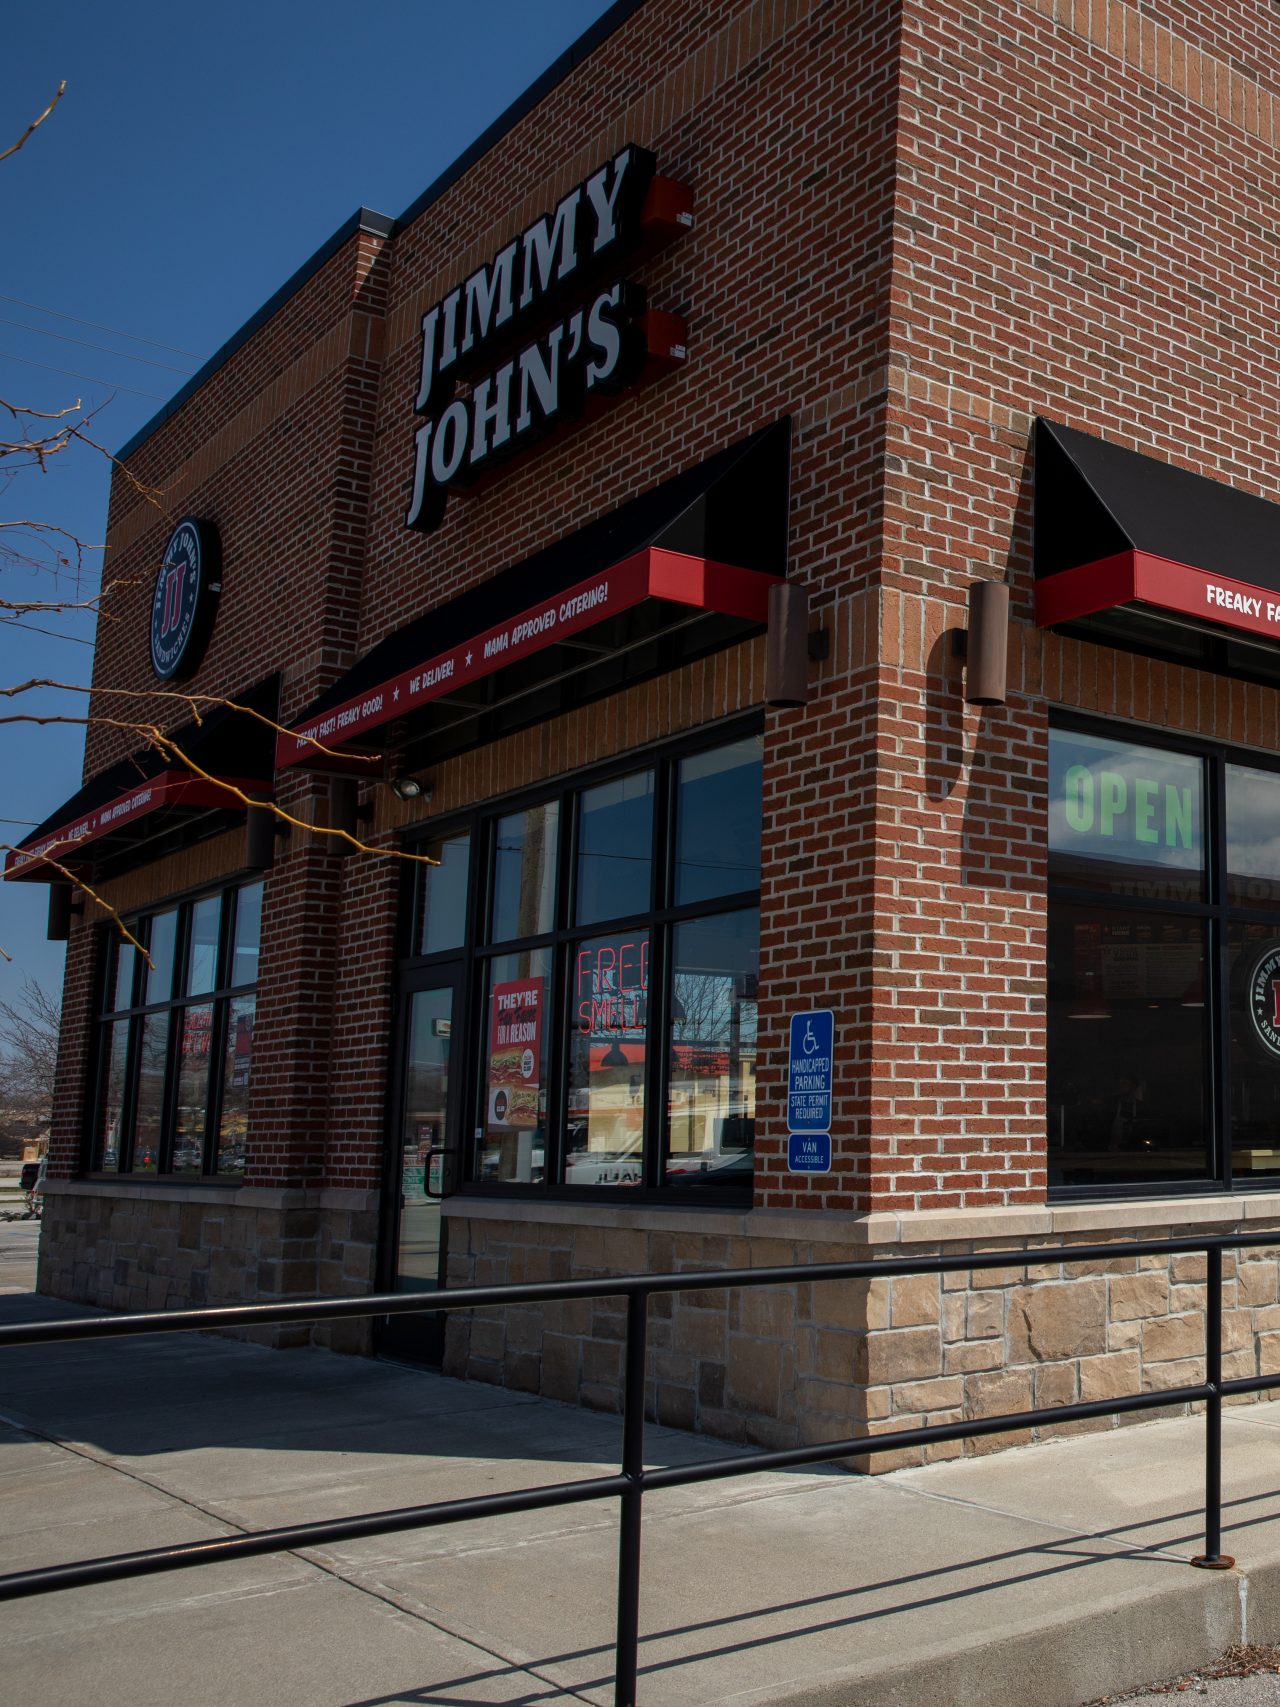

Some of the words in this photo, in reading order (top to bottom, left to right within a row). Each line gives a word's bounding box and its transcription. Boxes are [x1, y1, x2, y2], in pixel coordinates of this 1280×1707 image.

[414, 148, 631, 411] JIMMY
[405, 282, 621, 527] JOHN'S
[160, 560, 187, 639] JJ
[1206, 584, 1262, 618] FREAKY
[483, 631, 509, 660] MAMA
[511, 608, 556, 645] APPROVED
[559, 581, 609, 623] CATERING!
[409, 677, 421, 695] WE
[422, 658, 455, 687] DELIVER!
[319, 715, 336, 738] FAST!
[337, 705, 362, 730] FREAKY
[362, 693, 383, 718] GOOD!
[1065, 764, 1193, 850] OPEN
[577, 941, 649, 997] FREE
[497, 989, 538, 1011] THEY'RE
[577, 994, 648, 1035] SMELL
[510, 1021, 537, 1043] REASON
[791, 1057, 829, 1074] HANDICAPPED
[795, 1075, 826, 1090] PARKING
[791, 1095, 806, 1107] STATE
[808, 1094, 829, 1107] PERMIT
[795, 1107, 823, 1119] REQUIRED
[795, 1155, 824, 1164] ACCESSIBLE
[802, 1141, 817, 1153] VAN
